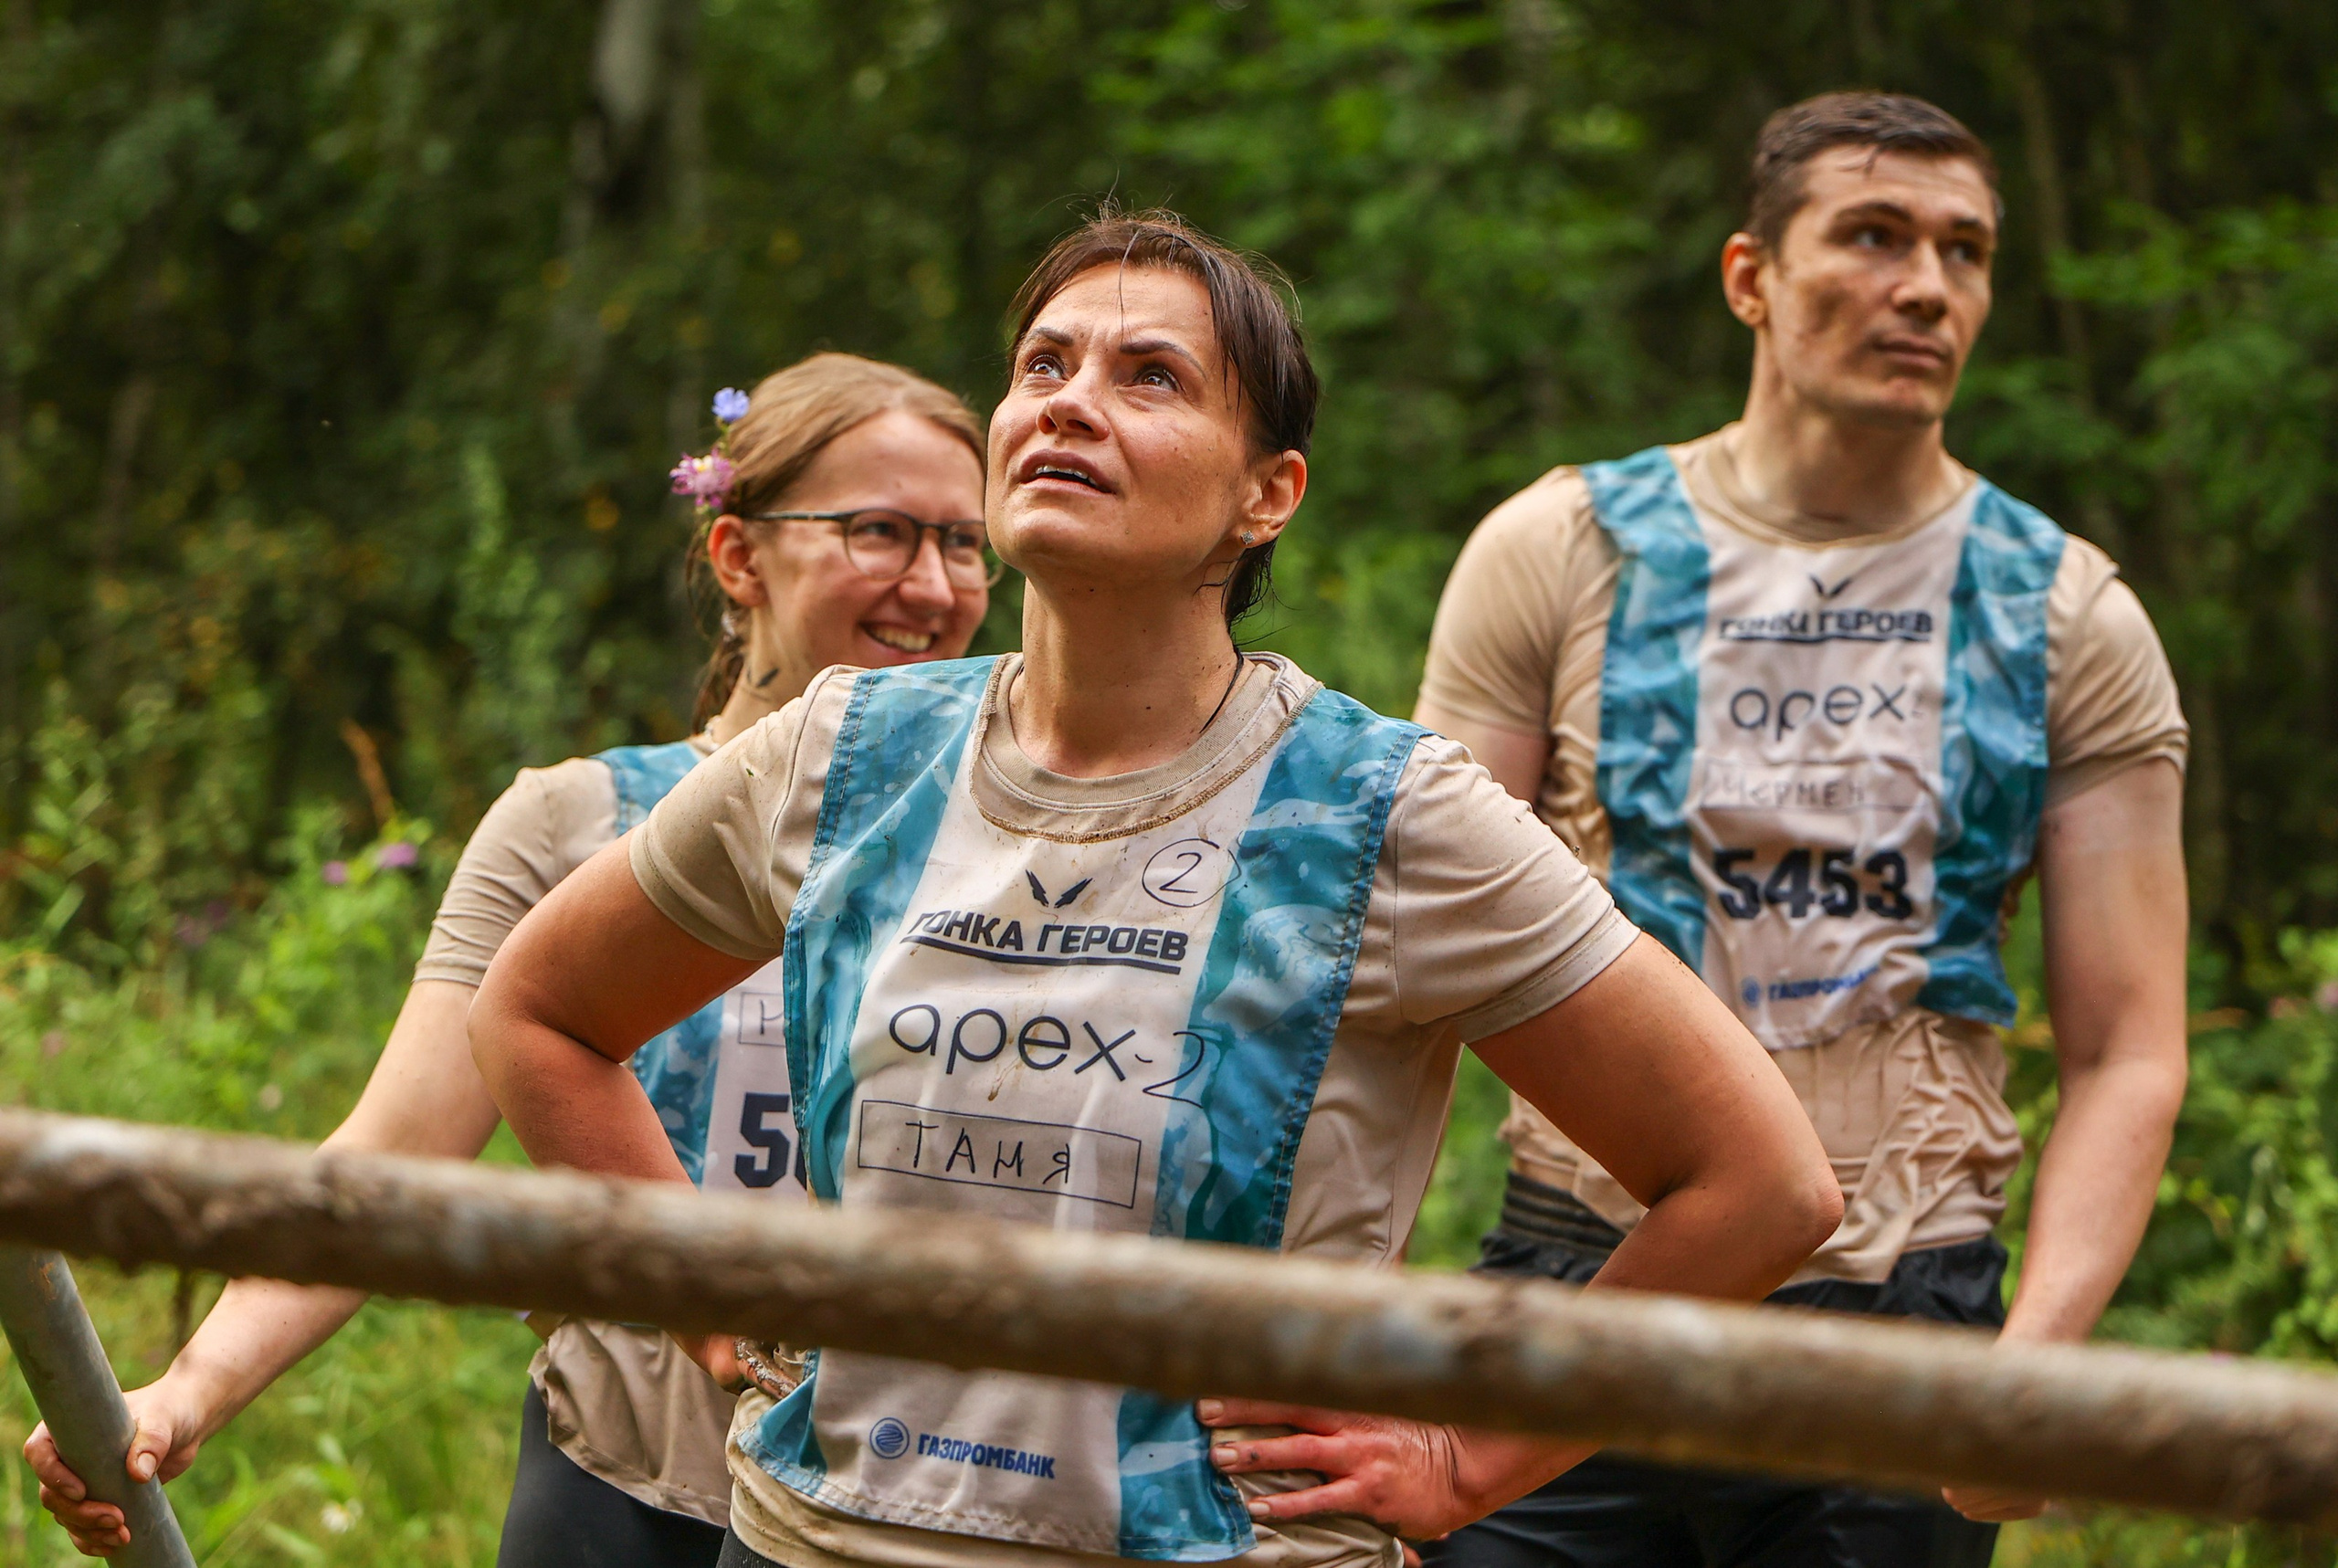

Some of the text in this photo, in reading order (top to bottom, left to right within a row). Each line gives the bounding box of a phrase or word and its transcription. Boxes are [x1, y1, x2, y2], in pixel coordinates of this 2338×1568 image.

[1730, 683, 1905, 742] apex
[1159, 851, 1197, 894] 2
[1713, 847, 1914, 920] 5453
[908, 910, 1189, 962] ГОНКА ГЕРОЕВ
[734, 1092, 806, 1191] 5
[917, 1432, 1057, 1479] ГАЗПРОМБАНК
